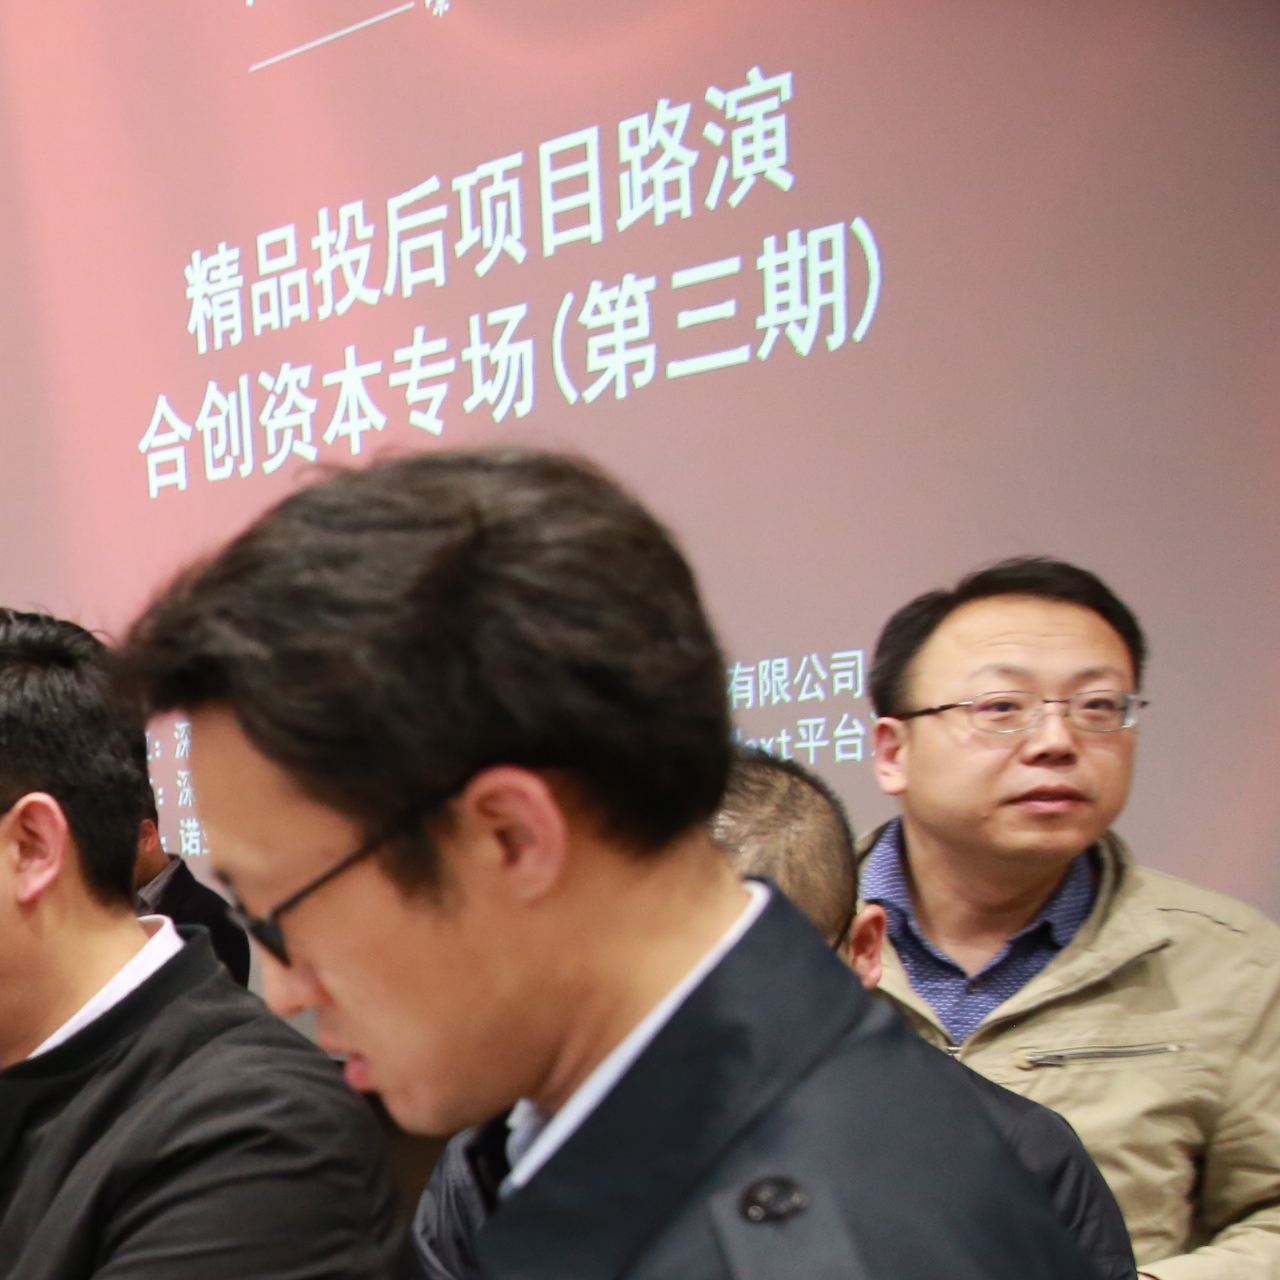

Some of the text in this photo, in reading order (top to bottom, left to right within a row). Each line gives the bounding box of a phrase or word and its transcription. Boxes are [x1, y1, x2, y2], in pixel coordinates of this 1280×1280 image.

[184, 66, 795, 355] 精品投后项目路演
[138, 215, 882, 499] 合创资本专场(第三期)
[727, 649, 864, 709] 有限公司
